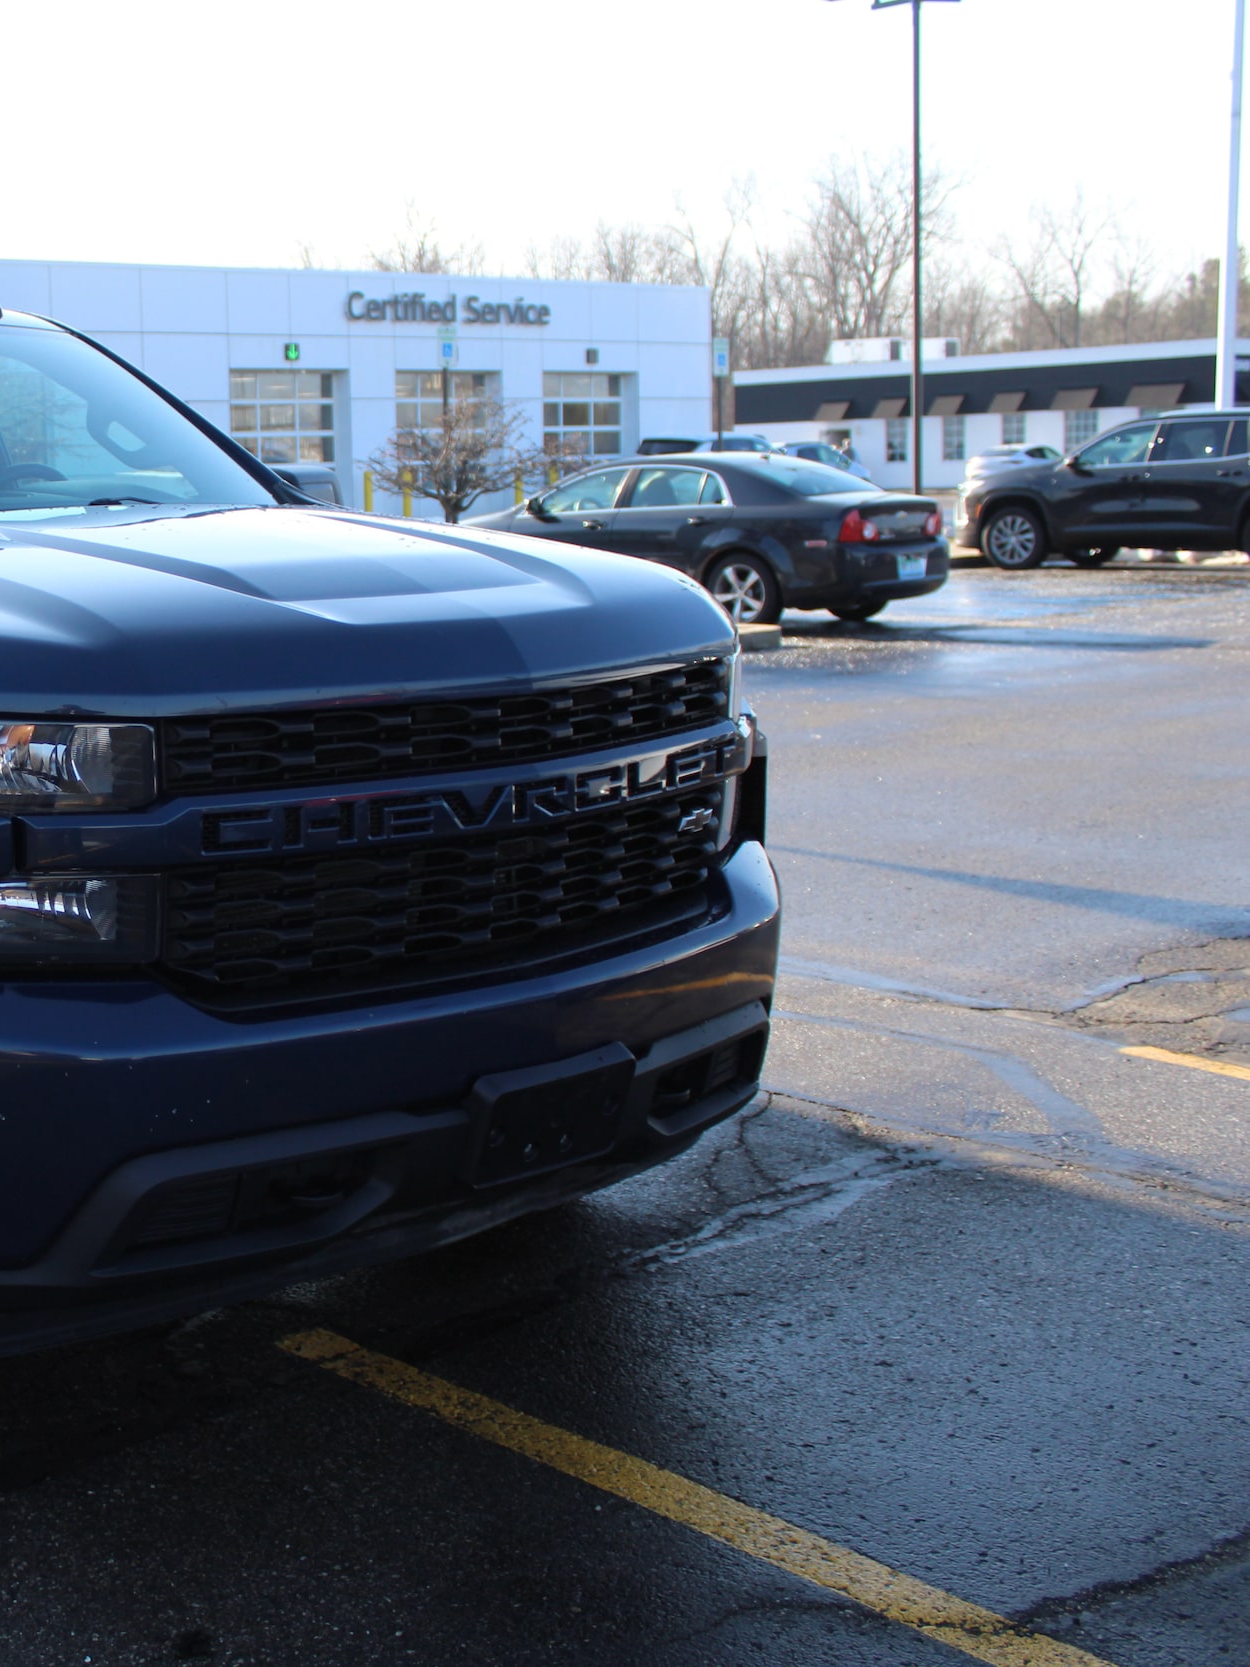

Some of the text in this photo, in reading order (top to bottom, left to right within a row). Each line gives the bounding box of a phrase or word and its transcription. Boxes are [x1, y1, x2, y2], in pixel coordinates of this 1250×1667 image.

[347, 291, 551, 325] Certified Service
[201, 736, 737, 857] CHEVROLET
